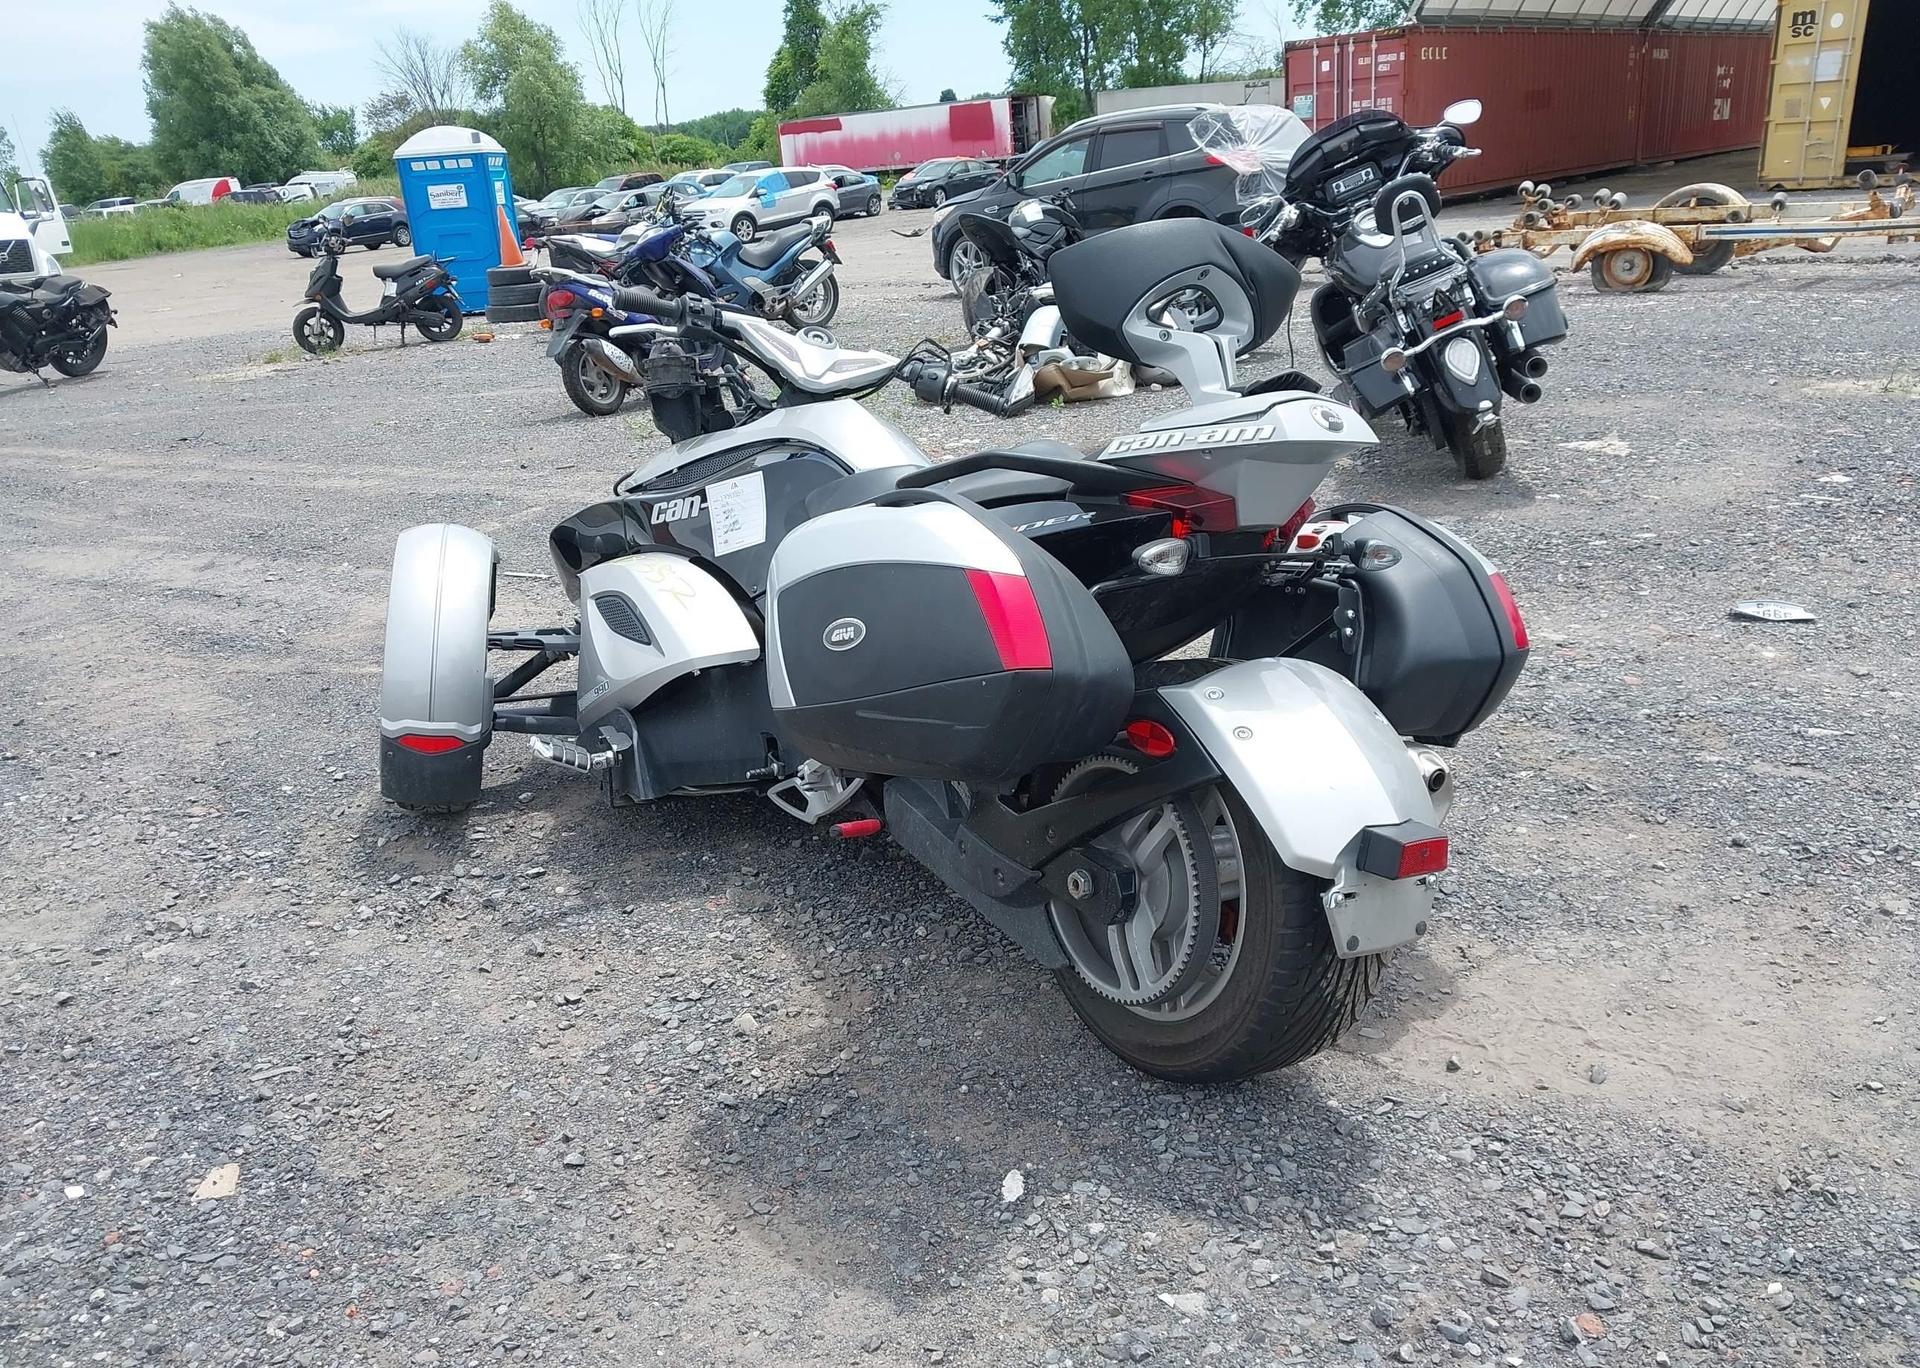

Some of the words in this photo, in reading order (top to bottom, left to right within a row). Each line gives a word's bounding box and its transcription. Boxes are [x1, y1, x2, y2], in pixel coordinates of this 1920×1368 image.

[1107, 424, 1276, 455] can-am
[650, 495, 710, 525] can-
[1012, 511, 1097, 532] DER
[831, 626, 855, 642] GIVI
[593, 680, 610, 699] 990
